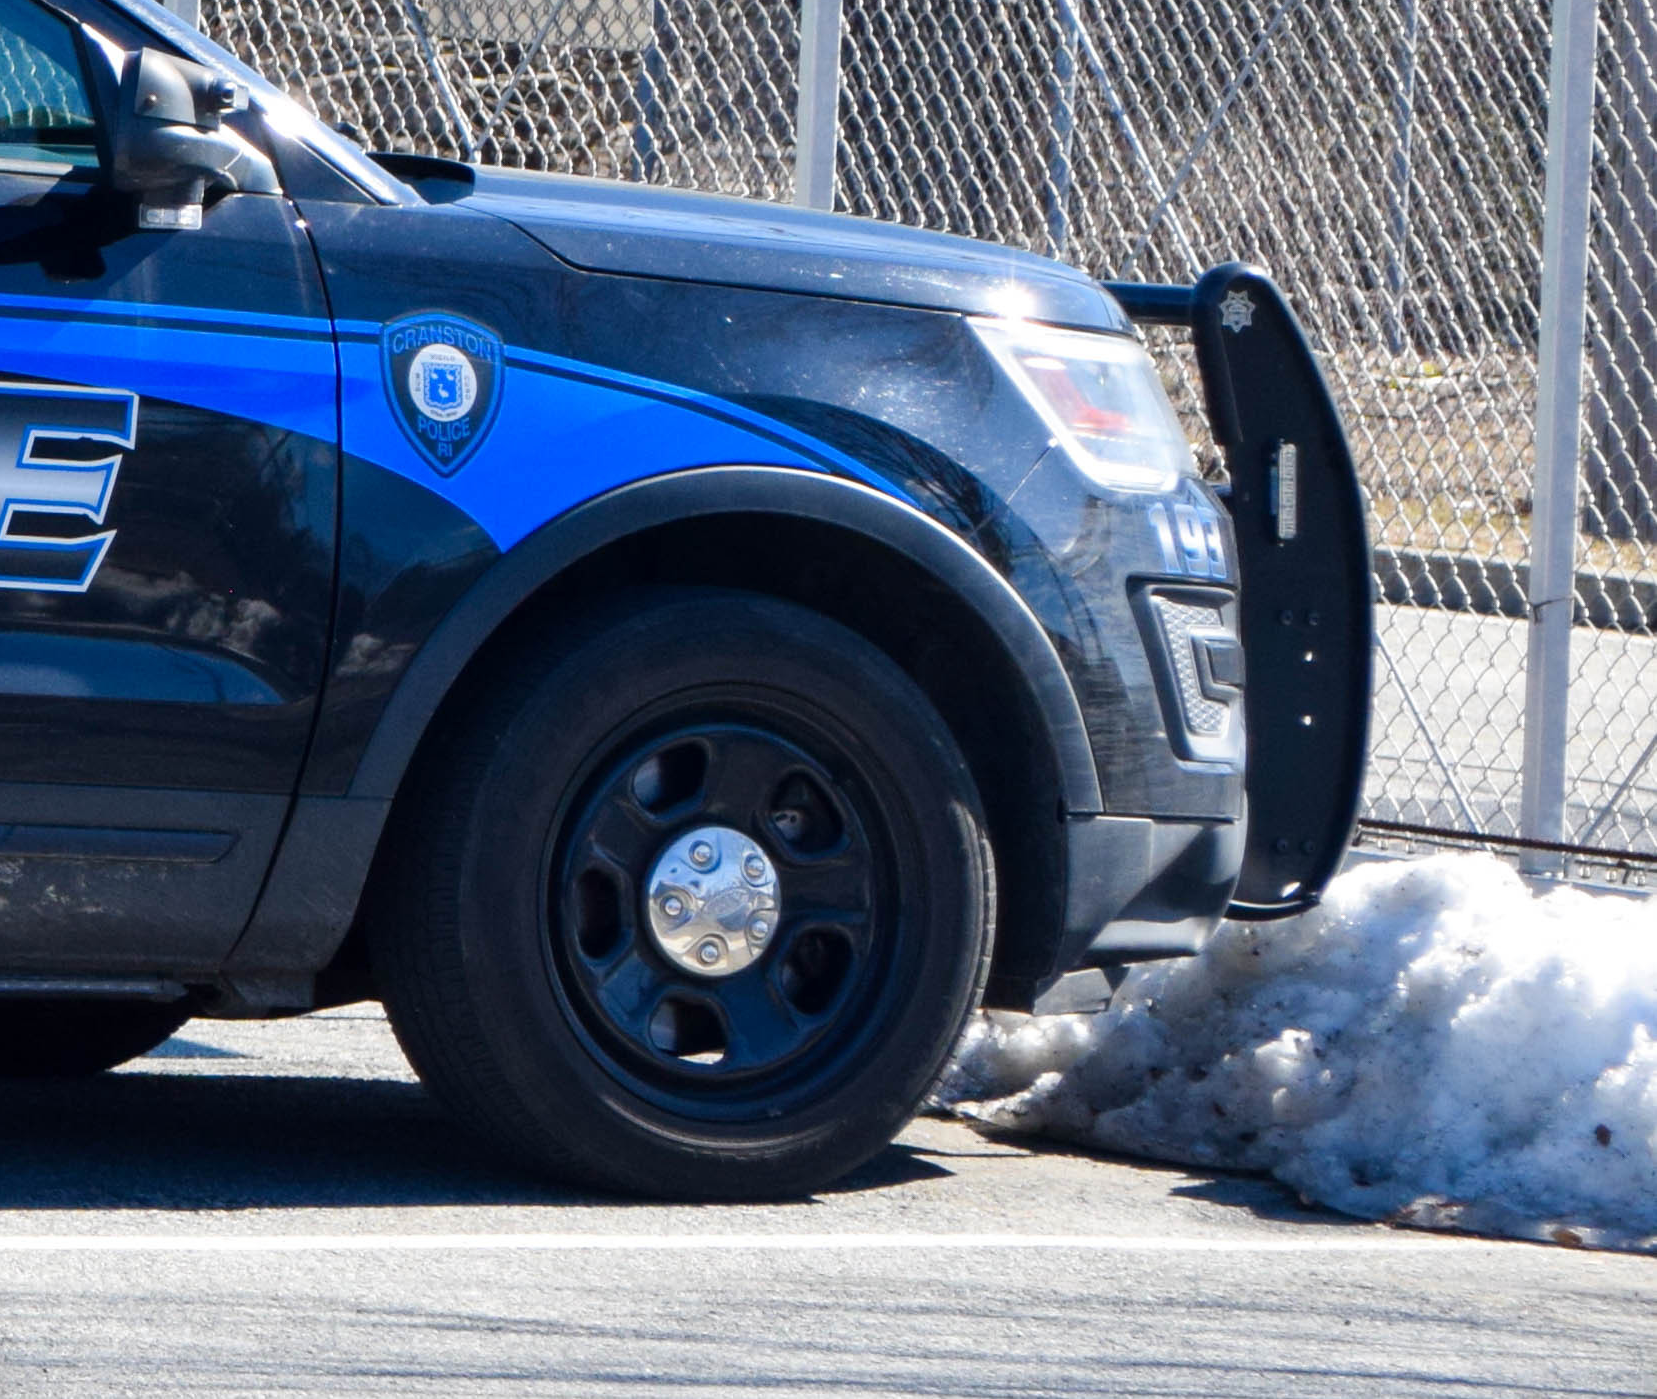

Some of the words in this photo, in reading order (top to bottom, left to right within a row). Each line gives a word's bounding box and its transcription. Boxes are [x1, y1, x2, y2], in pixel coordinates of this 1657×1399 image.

[392, 323, 494, 362] CRANSTON
[417, 415, 471, 442] POLICE
[437, 442, 454, 457] RI
[1148, 501, 1228, 579] 193
